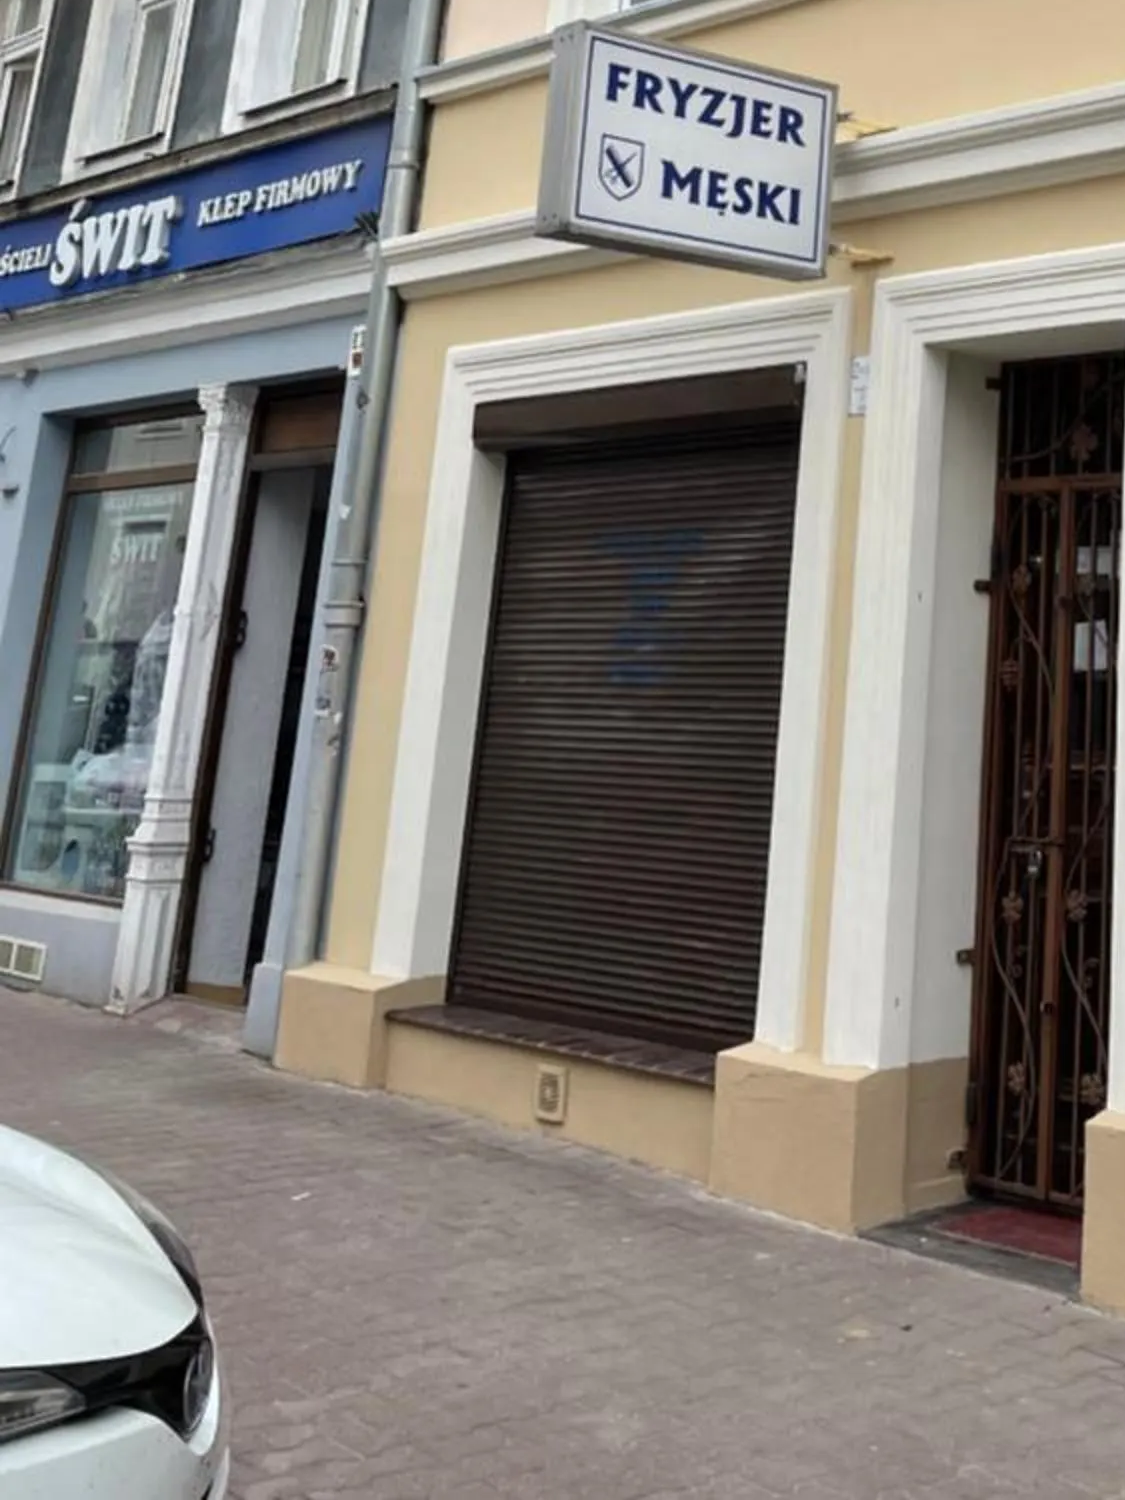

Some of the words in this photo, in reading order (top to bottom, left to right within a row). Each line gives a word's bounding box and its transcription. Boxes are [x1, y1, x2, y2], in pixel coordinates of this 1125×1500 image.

[605, 62, 806, 148] FRYZJER
[50, 198, 177, 286] ŚWIT
[197, 188, 255, 227] KLEP
[253, 159, 362, 213] FIRMOWY
[660, 158, 802, 226] MĘSKI
